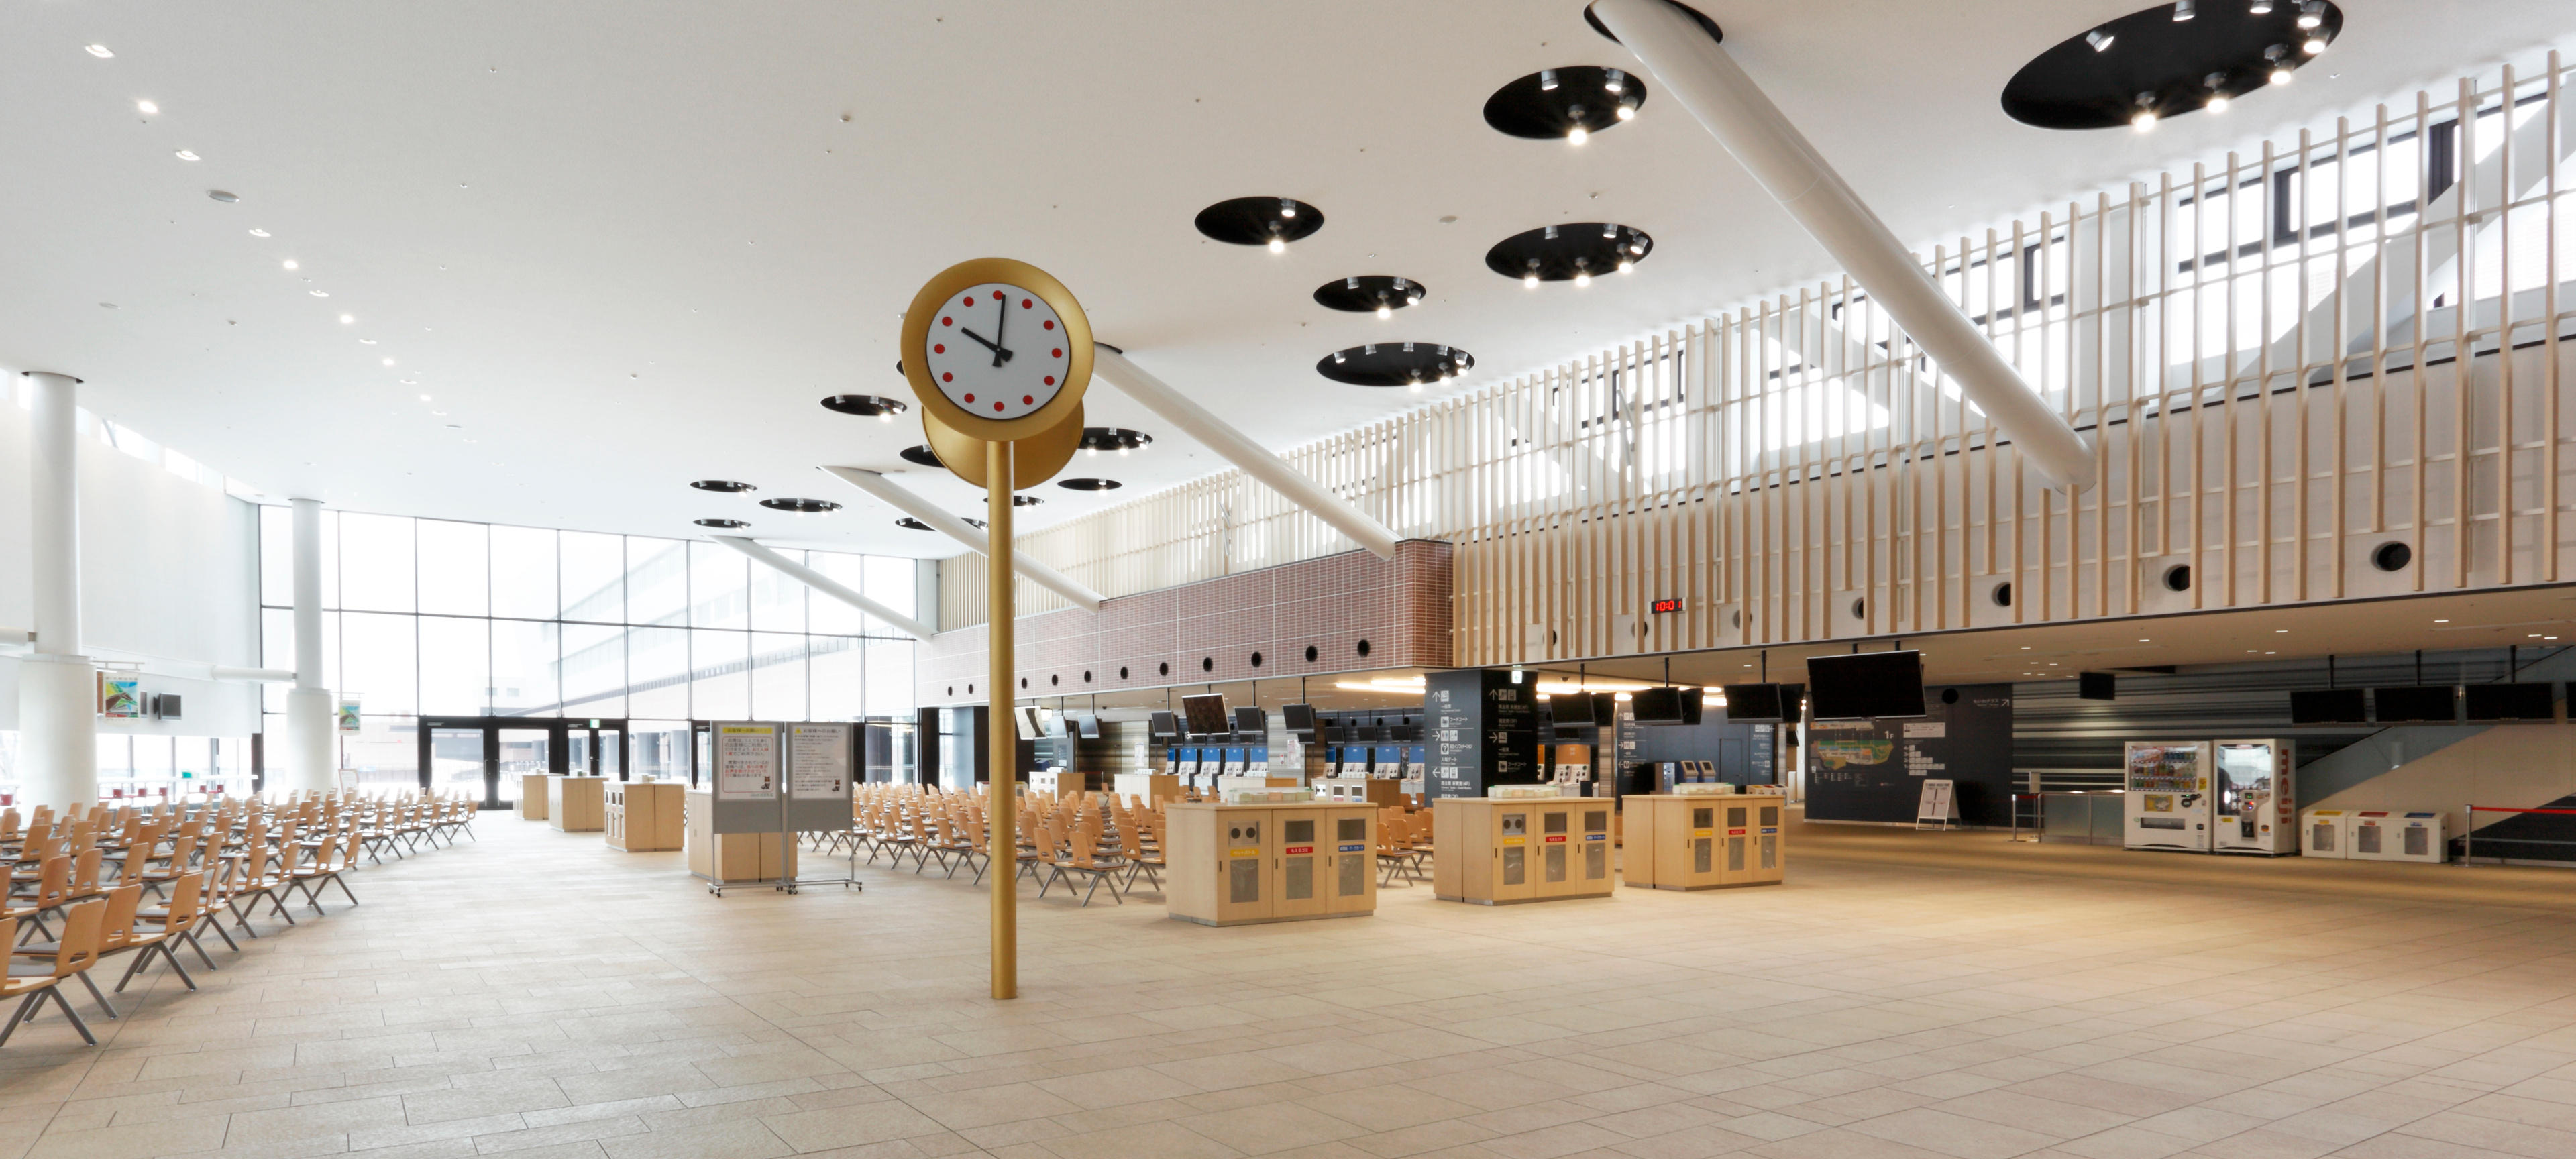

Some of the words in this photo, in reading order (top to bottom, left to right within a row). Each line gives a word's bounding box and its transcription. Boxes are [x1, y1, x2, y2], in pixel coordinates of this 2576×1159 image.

[1656, 600, 1682, 612] 10:01
[1884, 730, 1894, 739] 1F
[2277, 749, 2292, 824] meiji
